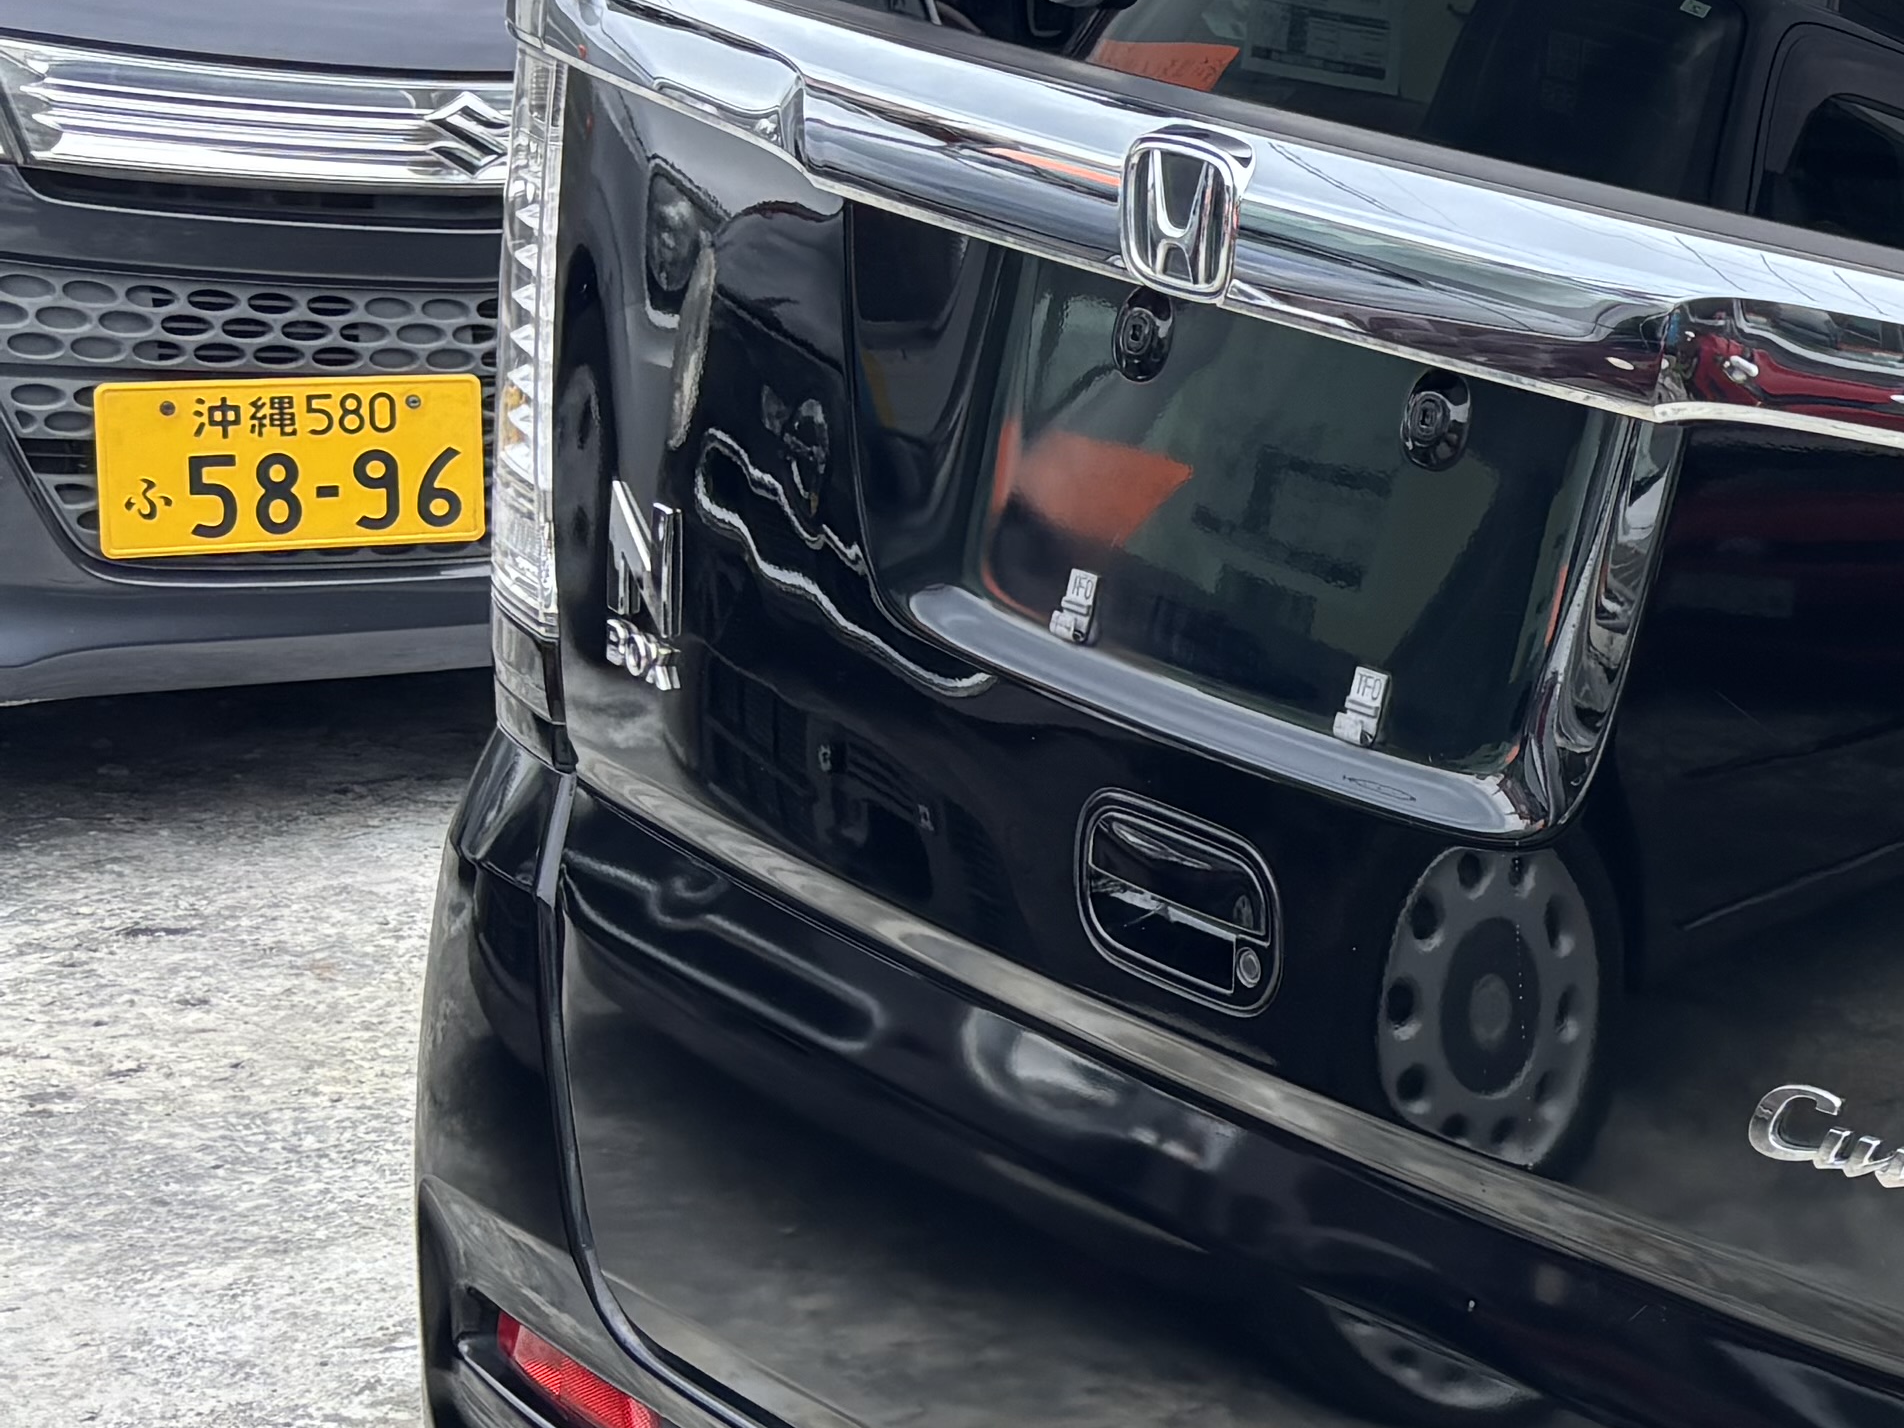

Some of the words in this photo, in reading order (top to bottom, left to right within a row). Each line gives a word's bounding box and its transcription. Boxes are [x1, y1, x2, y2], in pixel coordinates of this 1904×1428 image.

[124, 478, 173, 521] ふ
[187, 446, 462, 538] 58-96
[607, 480, 683, 638] N
